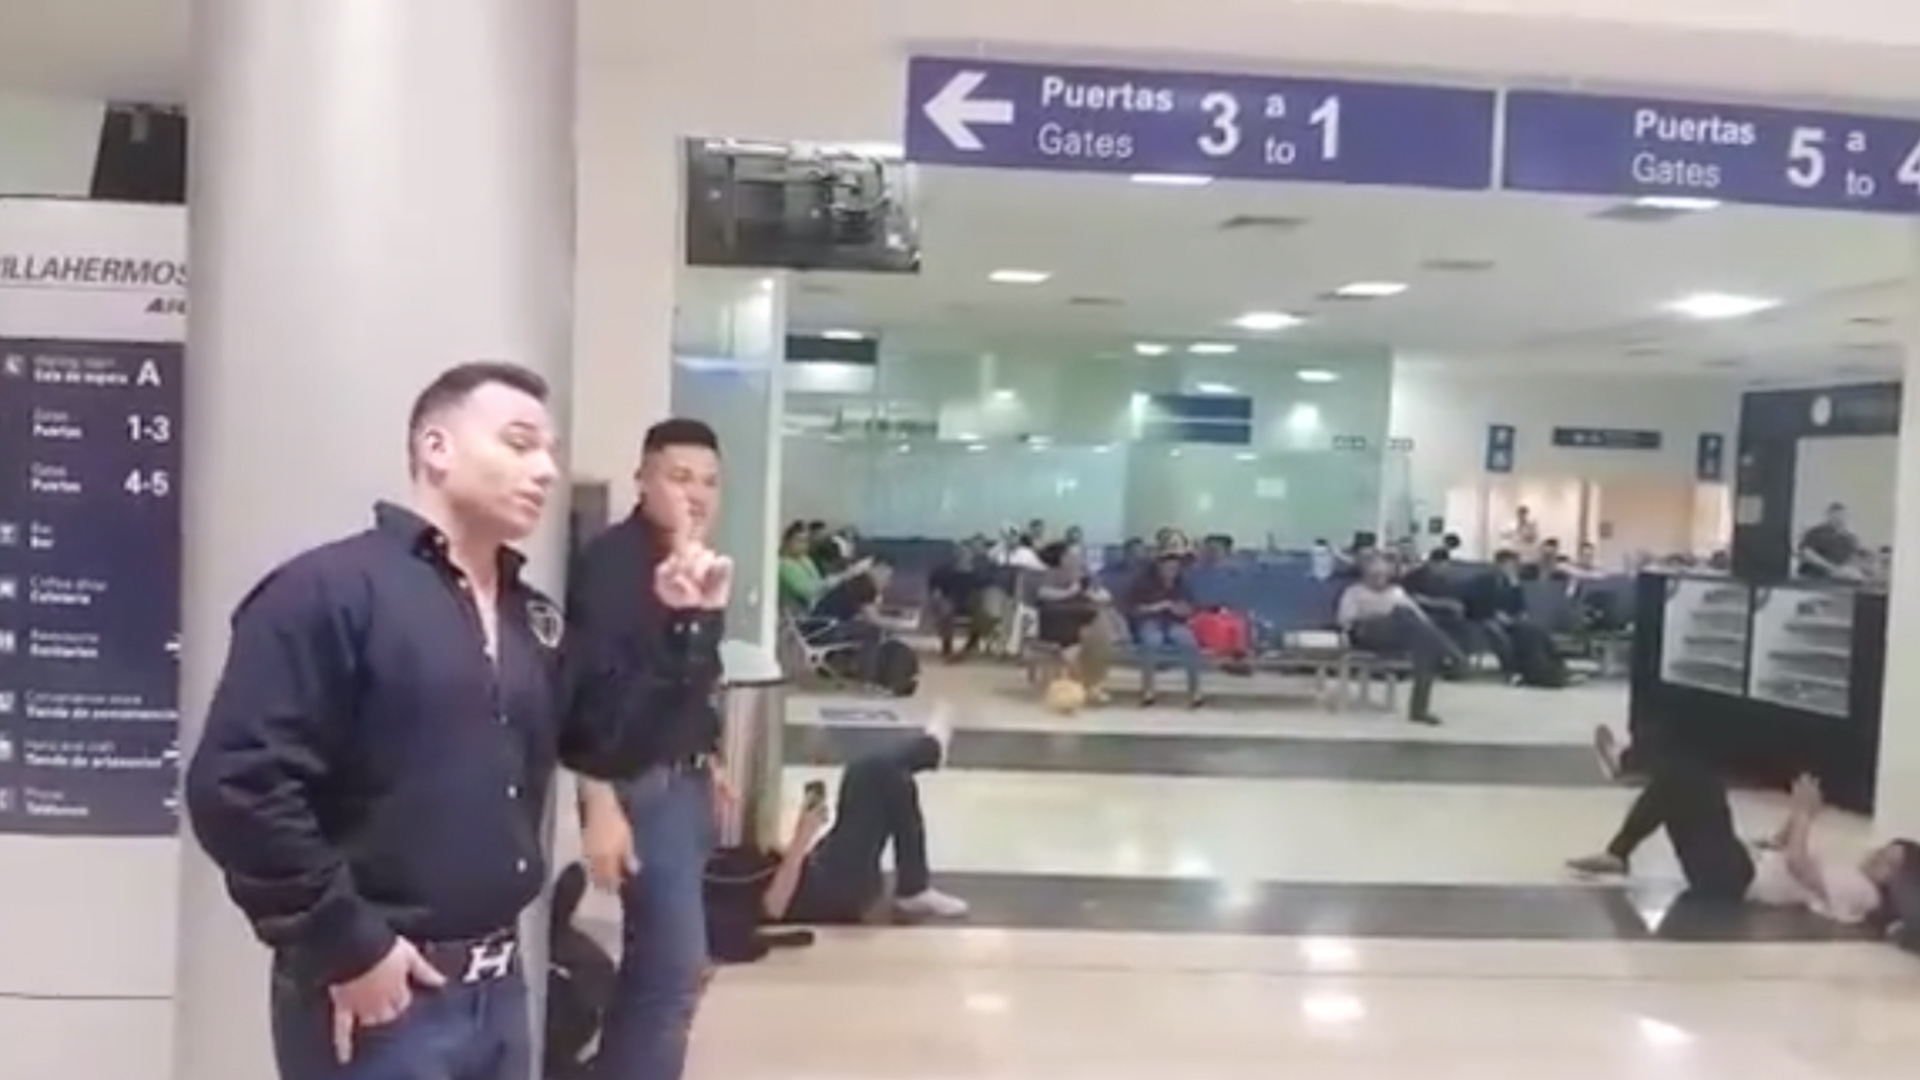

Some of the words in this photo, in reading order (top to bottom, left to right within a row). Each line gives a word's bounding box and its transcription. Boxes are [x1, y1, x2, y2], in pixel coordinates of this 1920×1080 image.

[1041, 75, 1175, 112] Puertas
[1197, 91, 1241, 155] 3
[1264, 93, 1286, 118] a
[1308, 96, 1341, 159] 1
[1038, 122, 1134, 159] Gates
[1264, 135, 1296, 164] to
[1634, 108, 1756, 145] Puertas
[1786, 126, 1826, 188] 5
[1845, 129, 1866, 152] a
[1631, 151, 1722, 188] Gates
[1844, 169, 1876, 196] to
[137, 358, 161, 387] A
[127, 414, 170, 442] 1-3
[124, 469, 169, 497] 4-5
[463, 941, 514, 982] H
